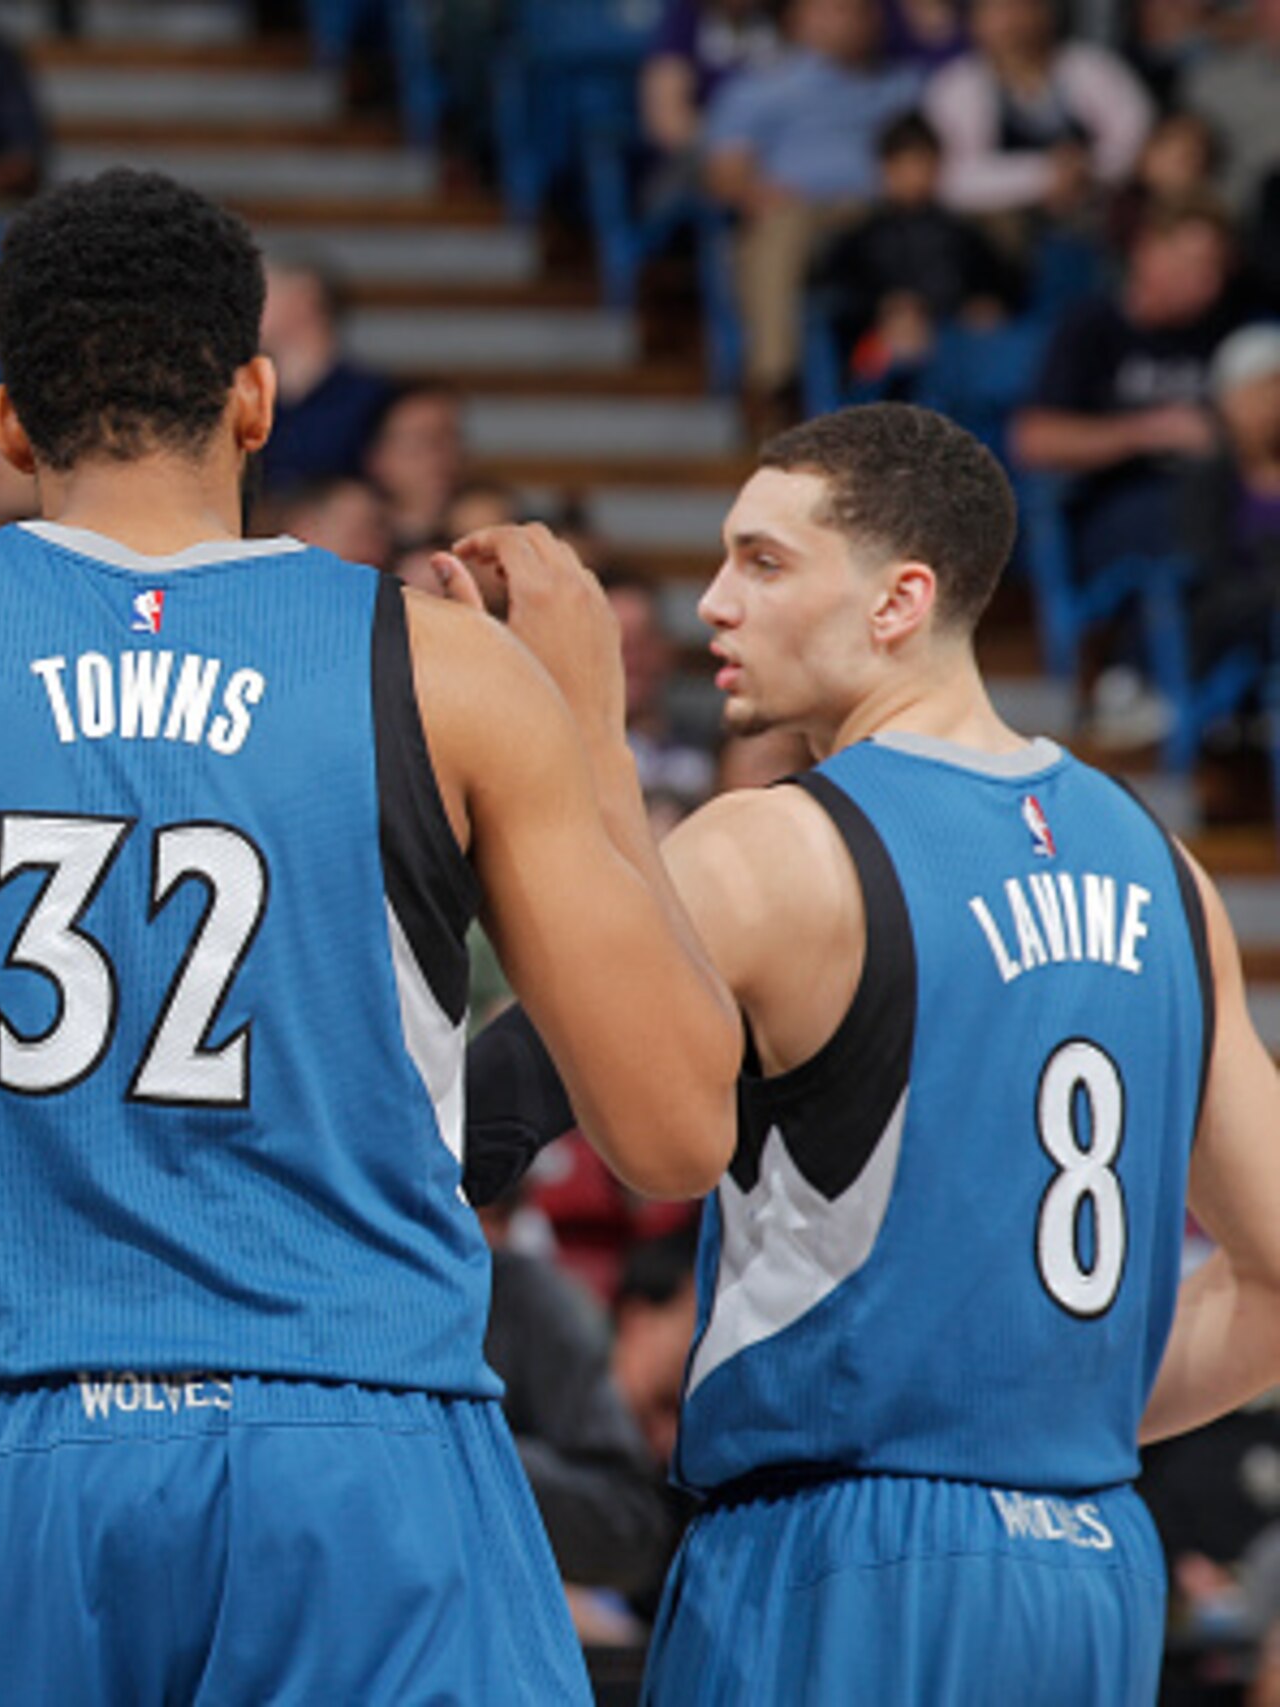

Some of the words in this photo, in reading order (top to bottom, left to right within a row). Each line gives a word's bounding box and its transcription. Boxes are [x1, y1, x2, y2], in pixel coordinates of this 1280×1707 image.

[30, 651, 265, 755] TOWNS
[969, 872, 1151, 983] LAVINE
[1035, 1035, 1128, 1321] 8
